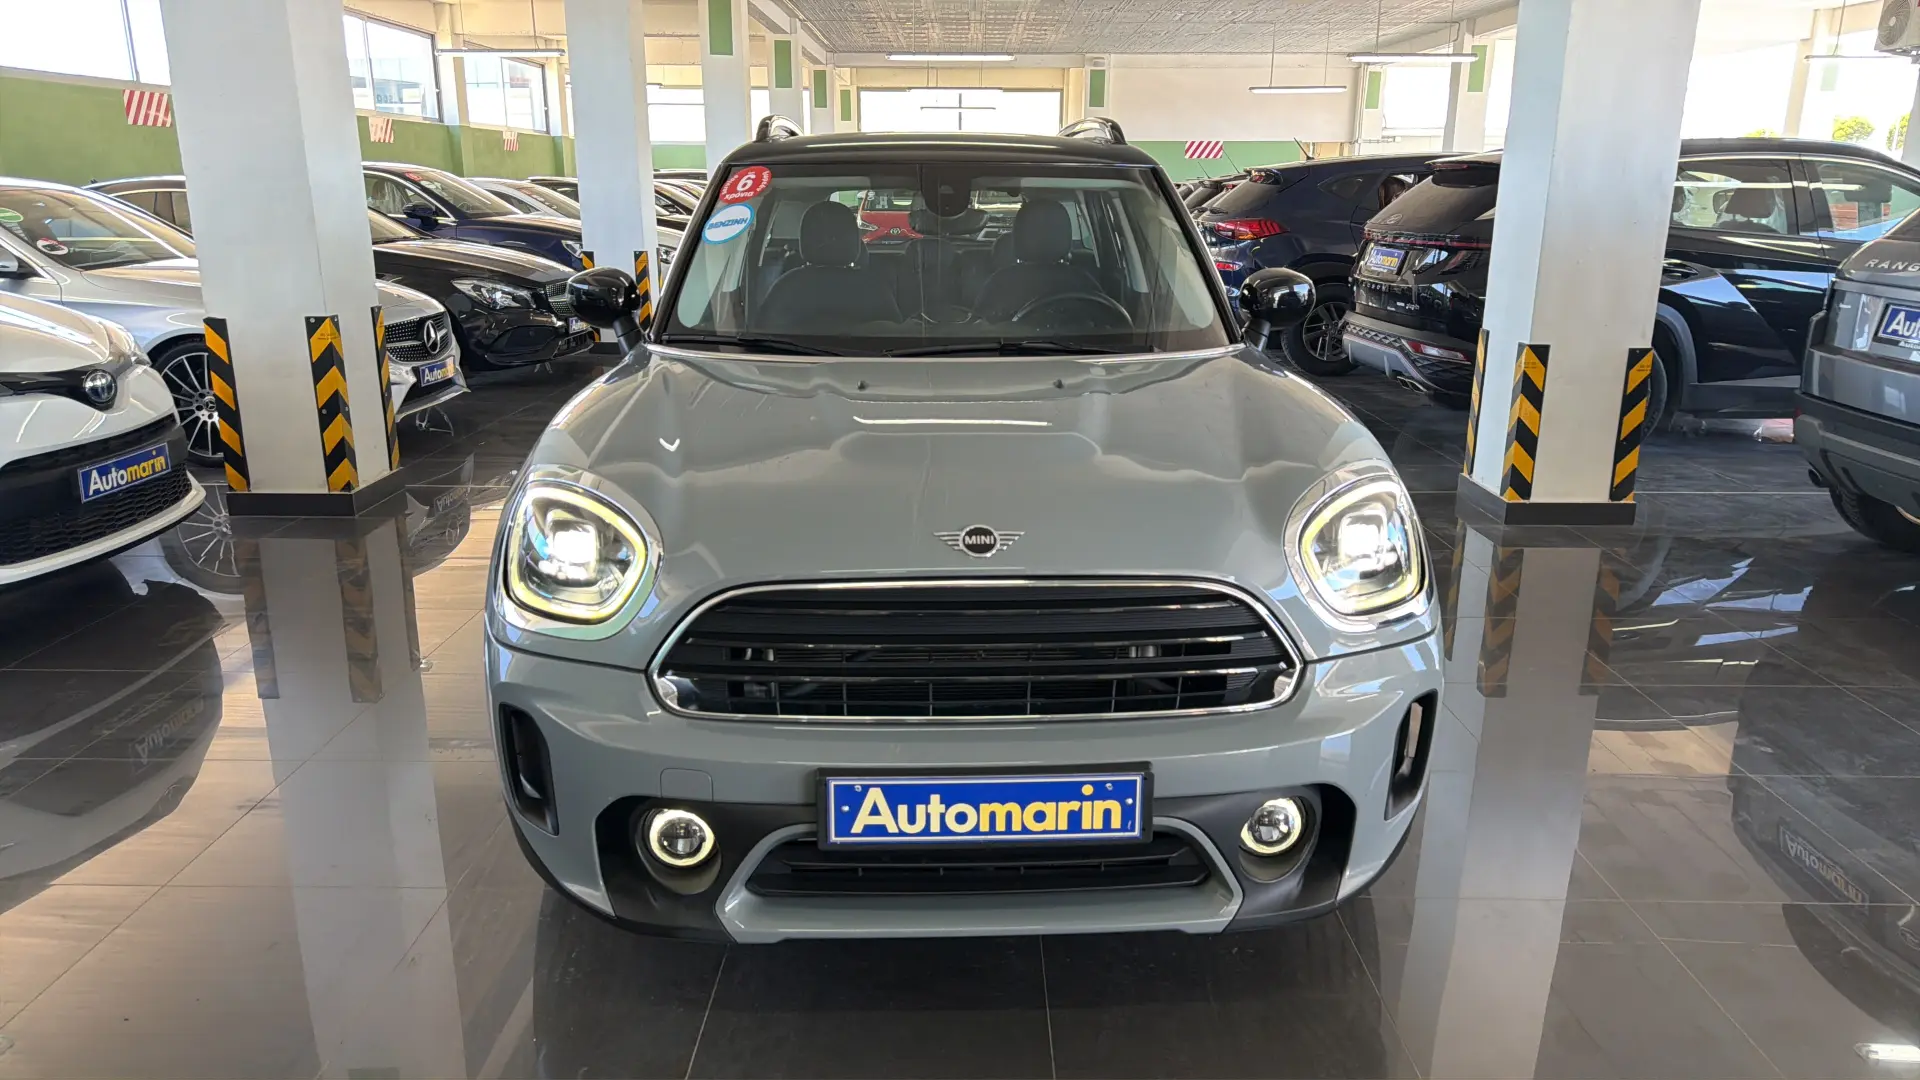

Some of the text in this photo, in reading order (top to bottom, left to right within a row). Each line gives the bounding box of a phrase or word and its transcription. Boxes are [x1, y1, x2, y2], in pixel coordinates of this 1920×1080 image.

[736, 174, 756, 191] 6
[88, 449, 167, 497] Automarin
[964, 535, 995, 545] MINI
[850, 784, 1122, 834] Automarin
